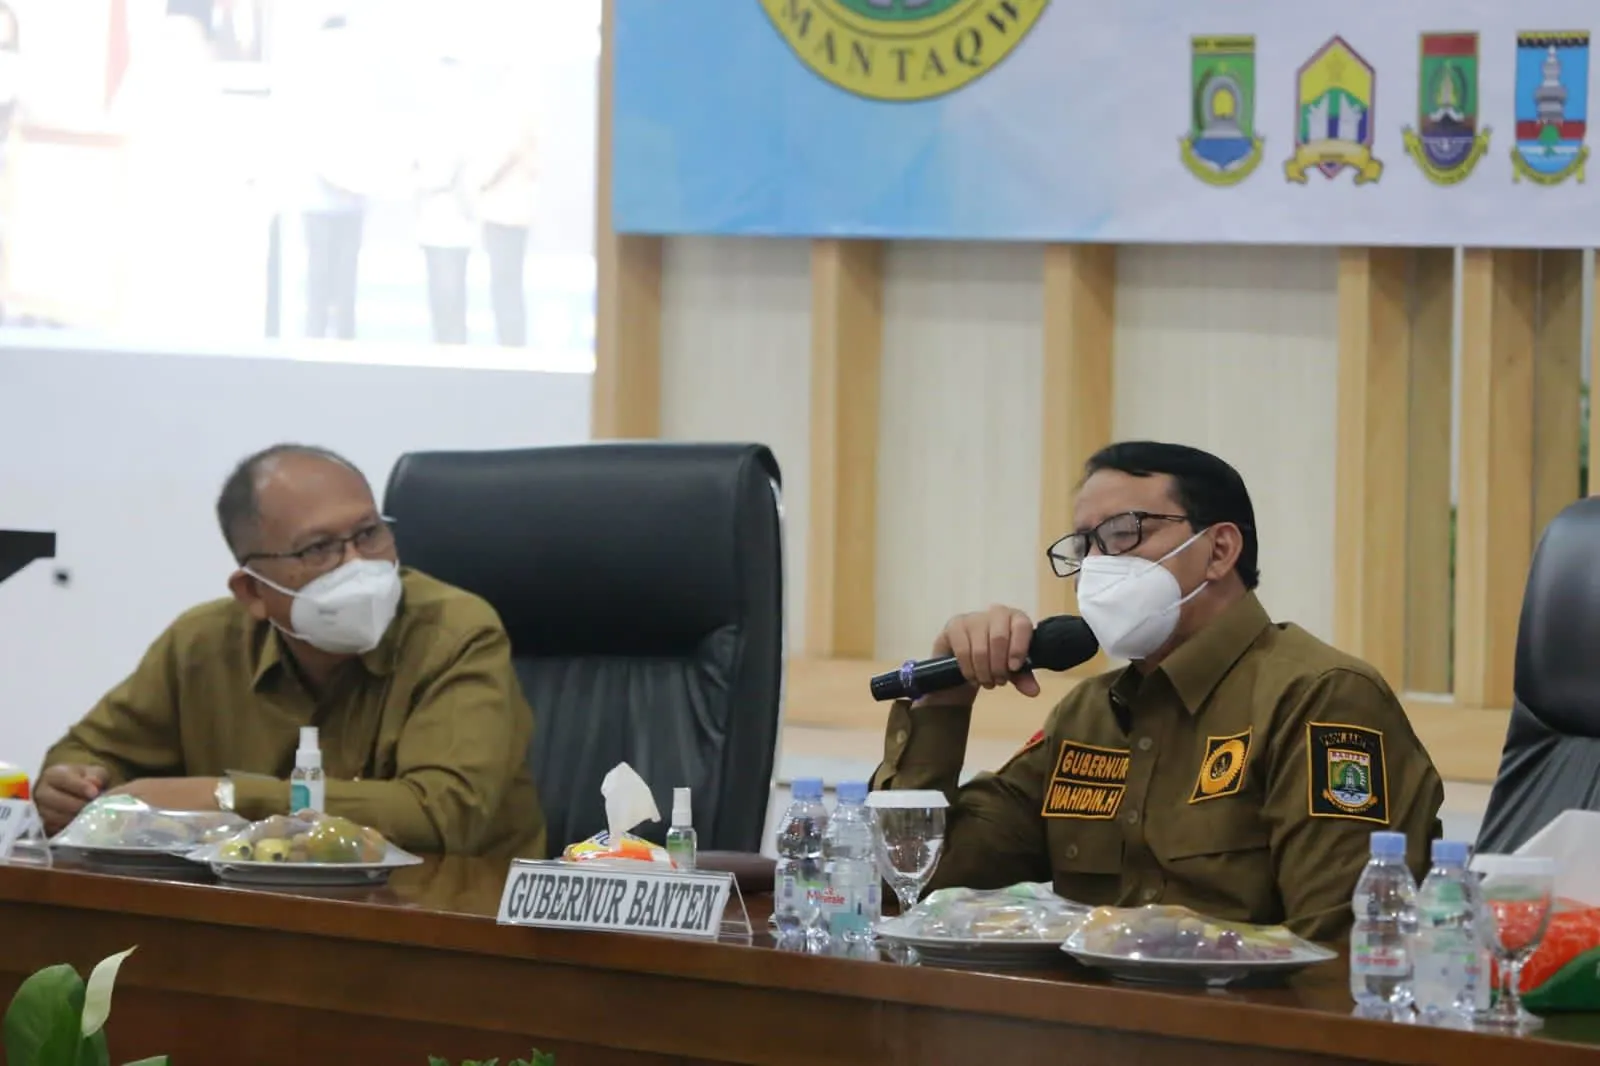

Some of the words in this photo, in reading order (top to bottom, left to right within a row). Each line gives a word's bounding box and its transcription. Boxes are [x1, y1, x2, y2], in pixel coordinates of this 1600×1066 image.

[1062, 750, 1130, 780] GUBERNUR
[507, 872, 628, 925] GUBERNUR
[625, 880, 721, 931] BANTEN
